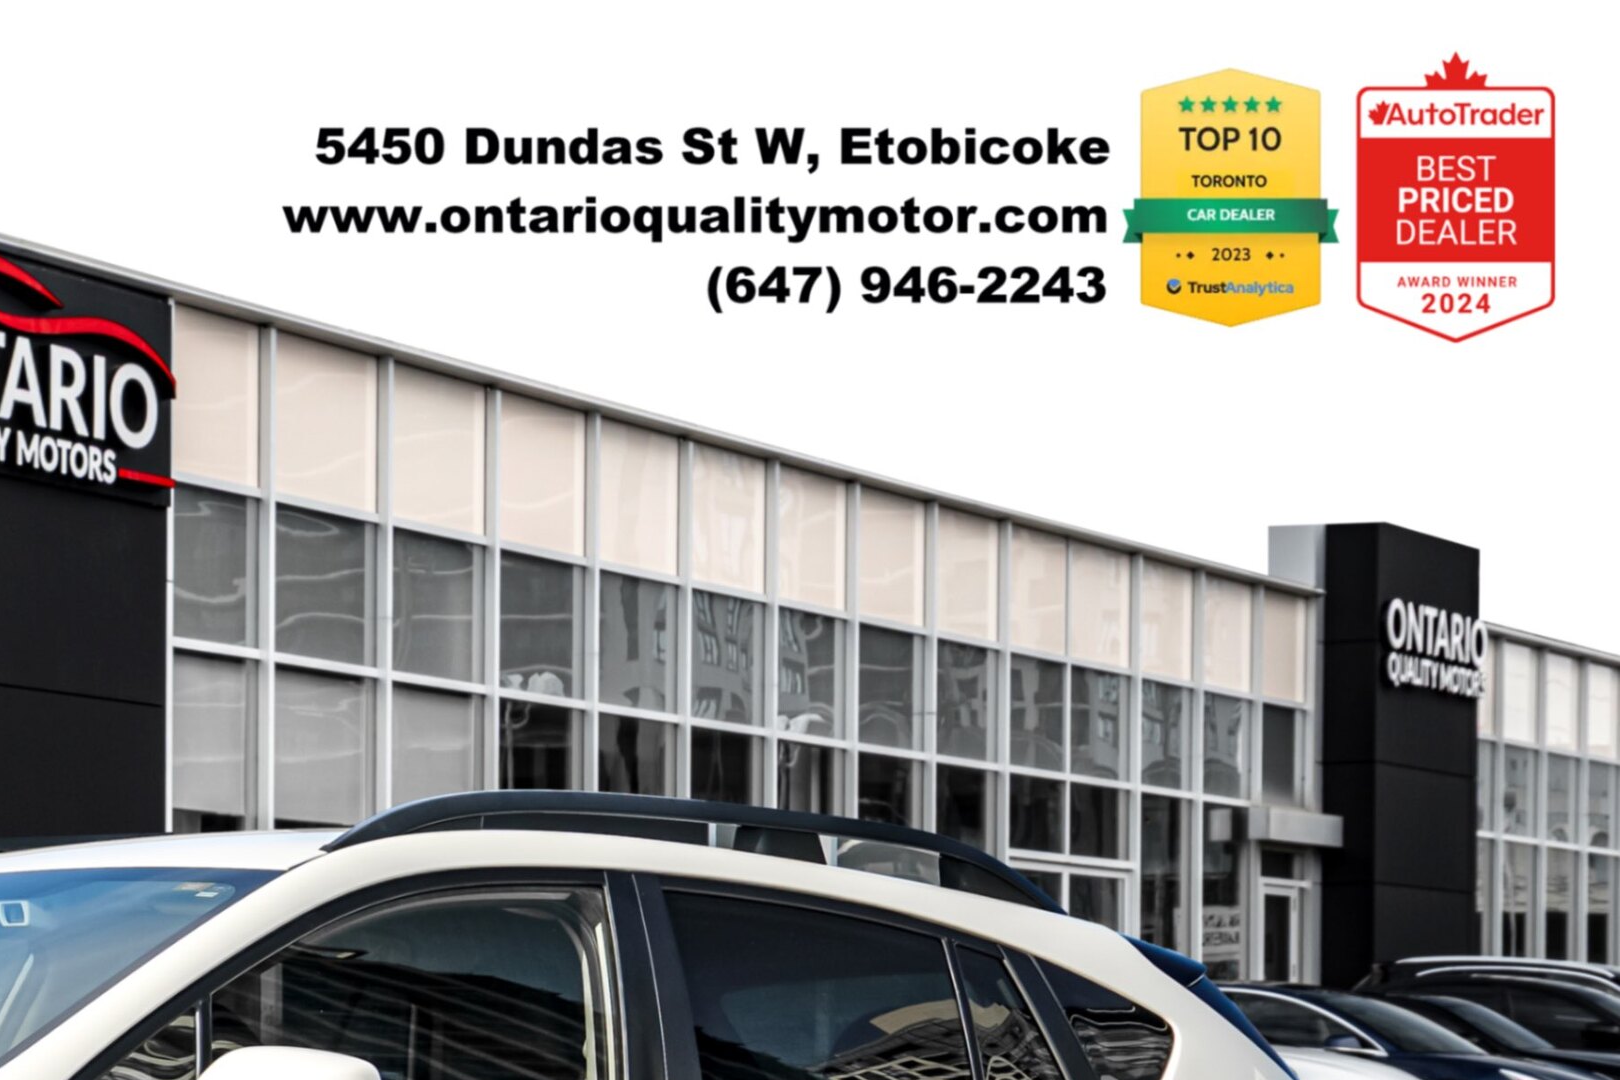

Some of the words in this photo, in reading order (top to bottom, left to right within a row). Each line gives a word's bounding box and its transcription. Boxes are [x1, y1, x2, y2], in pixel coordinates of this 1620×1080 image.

[17, 430, 117, 485] MOTORS
[1386, 597, 1488, 669] ONTARIO
[1386, 651, 1439, 689] QUALITY
